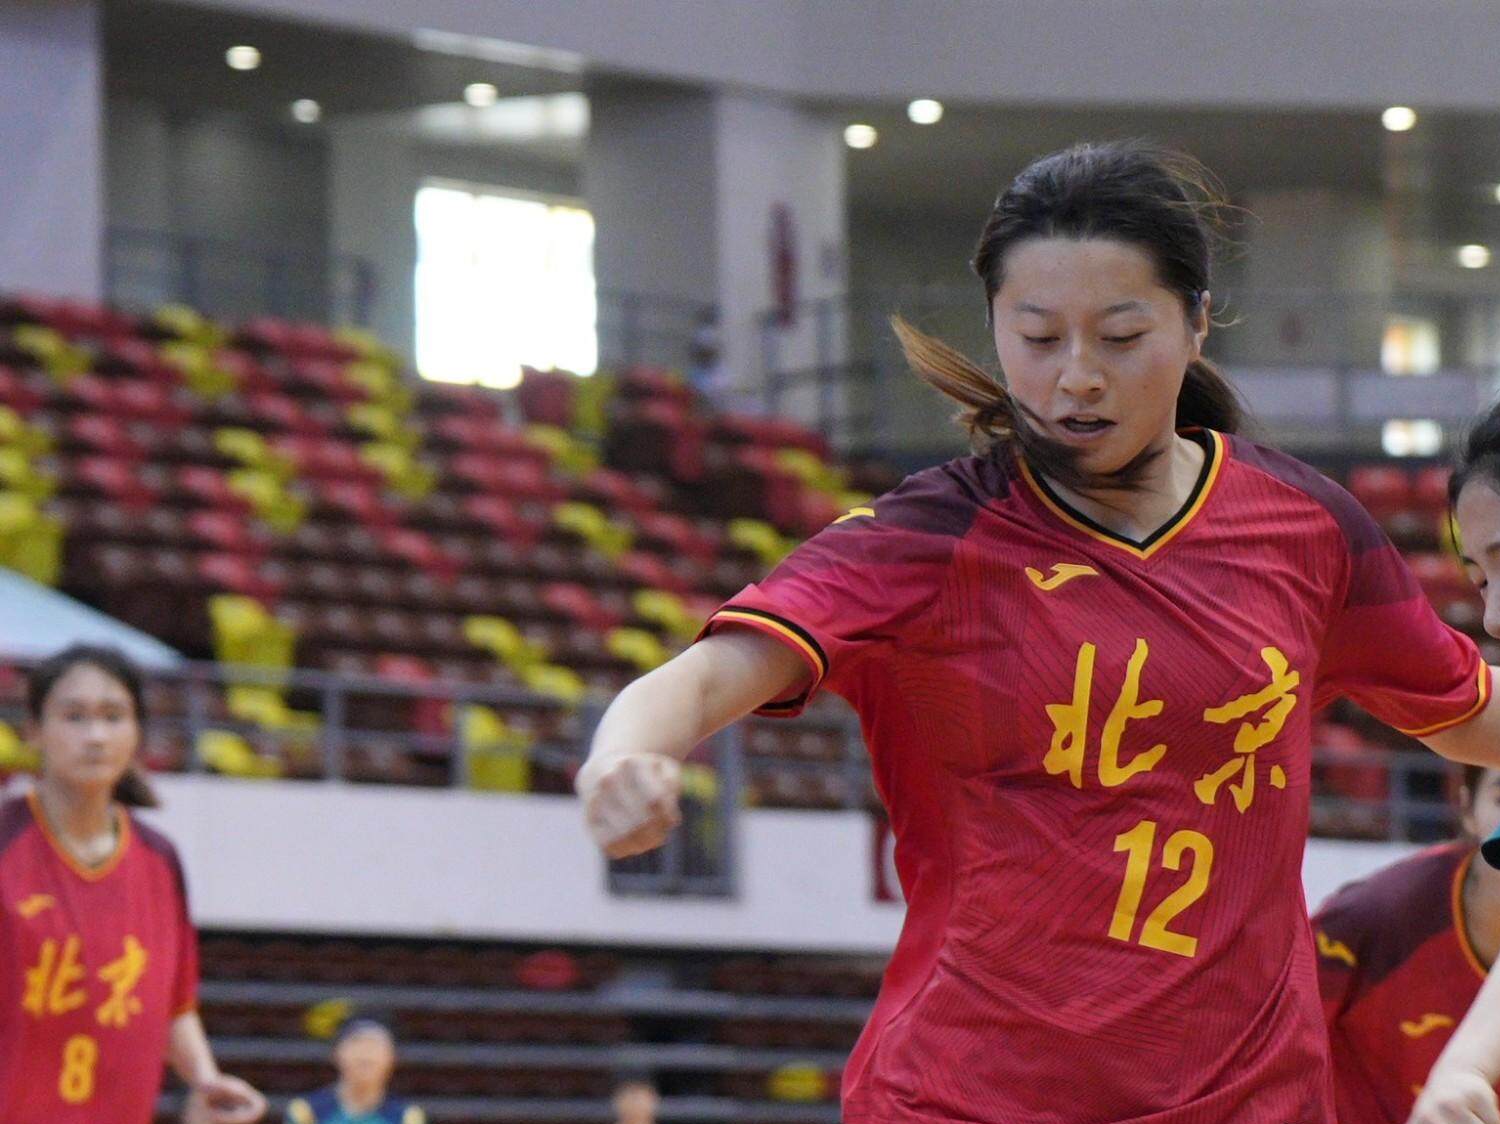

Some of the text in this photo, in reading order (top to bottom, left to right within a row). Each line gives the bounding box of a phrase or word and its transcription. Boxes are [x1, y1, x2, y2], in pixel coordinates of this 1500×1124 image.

[1043, 638, 1300, 814] 北京
[1108, 820, 1213, 957] 12
[22, 934, 147, 1028] 北京
[60, 1034, 97, 1101] 8
